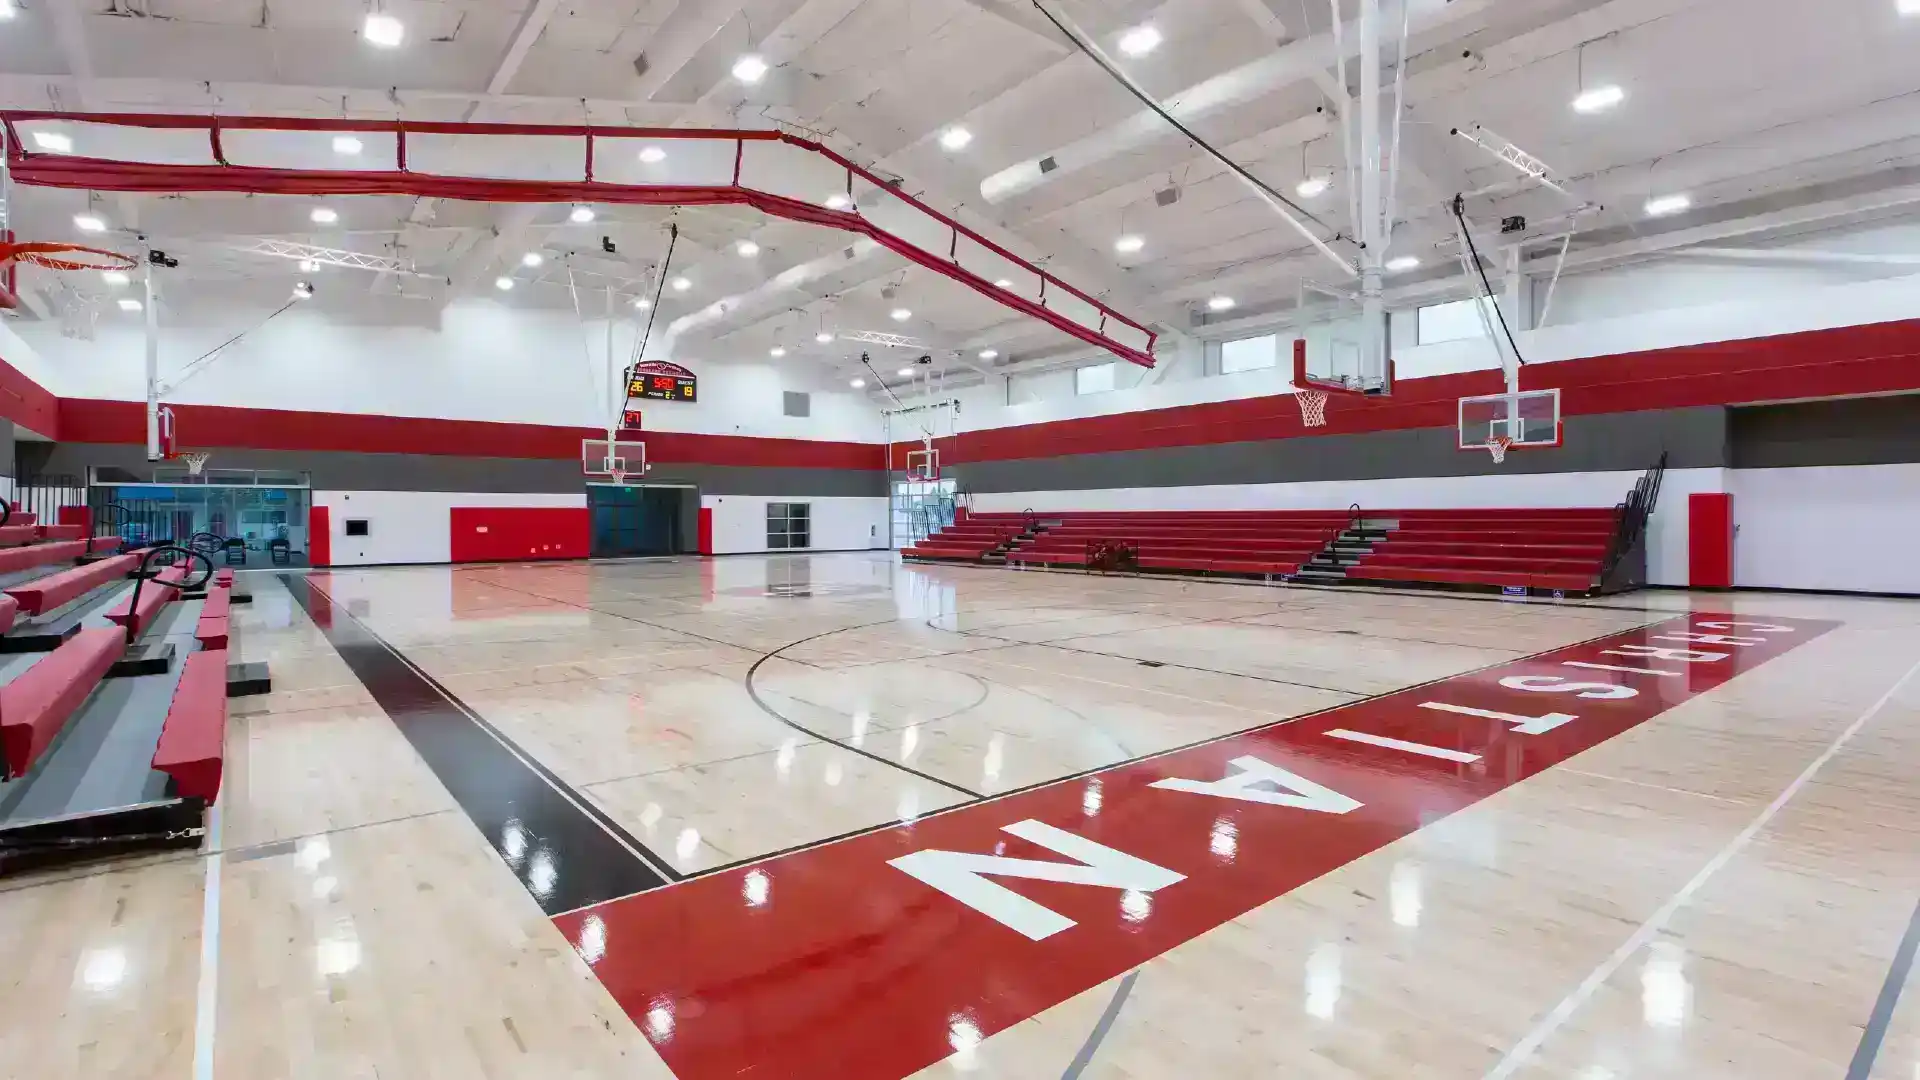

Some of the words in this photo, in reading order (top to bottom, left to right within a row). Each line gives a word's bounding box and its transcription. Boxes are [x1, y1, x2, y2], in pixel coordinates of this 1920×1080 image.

[631, 381, 643, 392] 26
[684, 386, 692, 396] 19
[626, 412, 639, 423] 27
[886, 621, 1796, 942] CHRISTIAN
